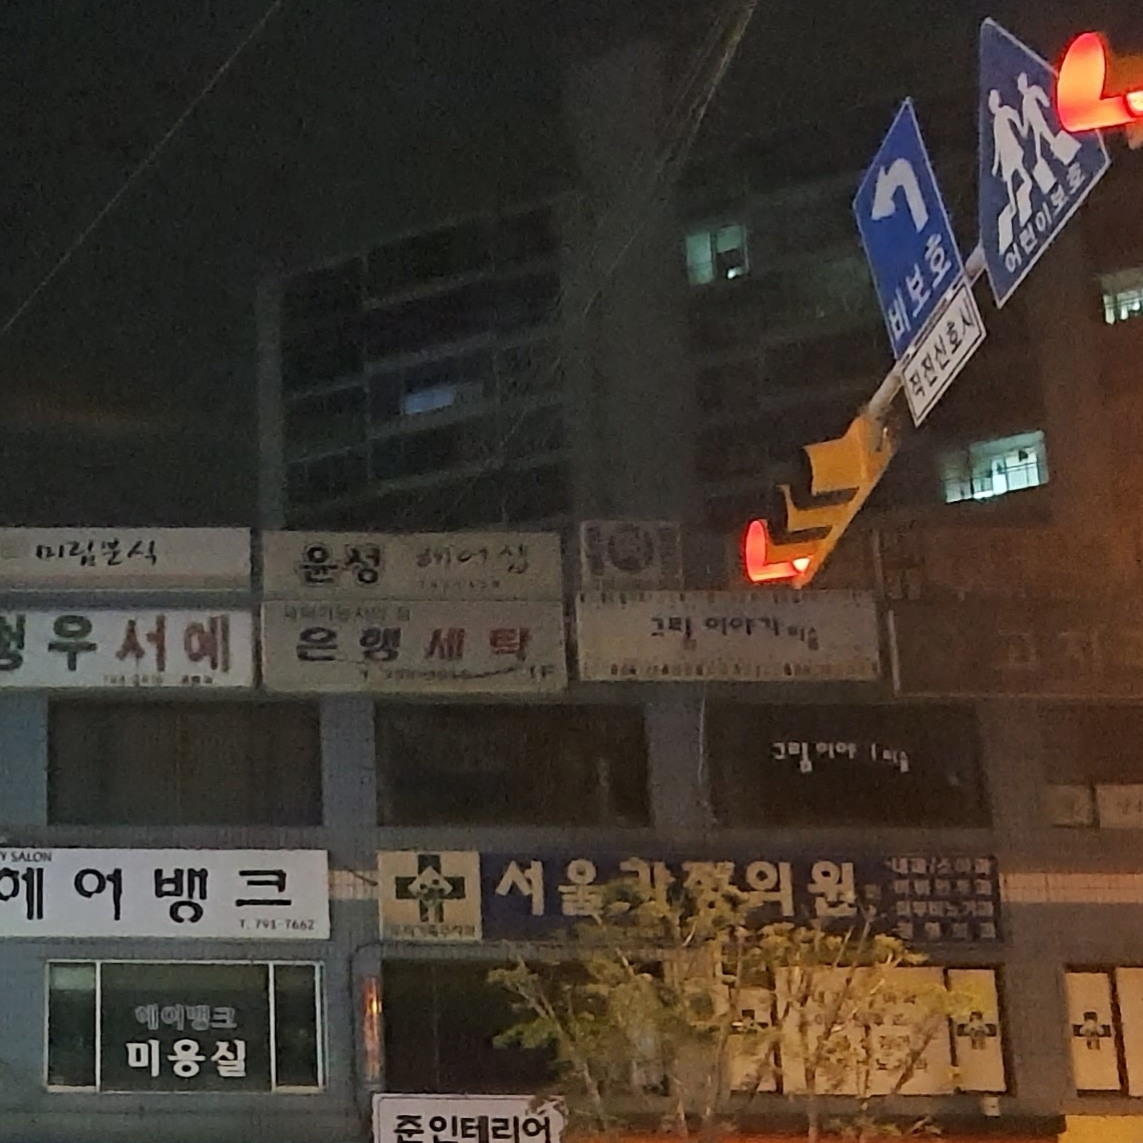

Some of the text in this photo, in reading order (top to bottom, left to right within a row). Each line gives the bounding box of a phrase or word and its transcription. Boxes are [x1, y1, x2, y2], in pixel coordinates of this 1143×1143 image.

[886, 233, 951, 338] 비보호
[908, 306, 975, 397] 직진신호시
[296, 625, 533, 663] 은행세탁
[10, 851, 53, 863] SALON
[125, 1038, 247, 1078] 미용실
